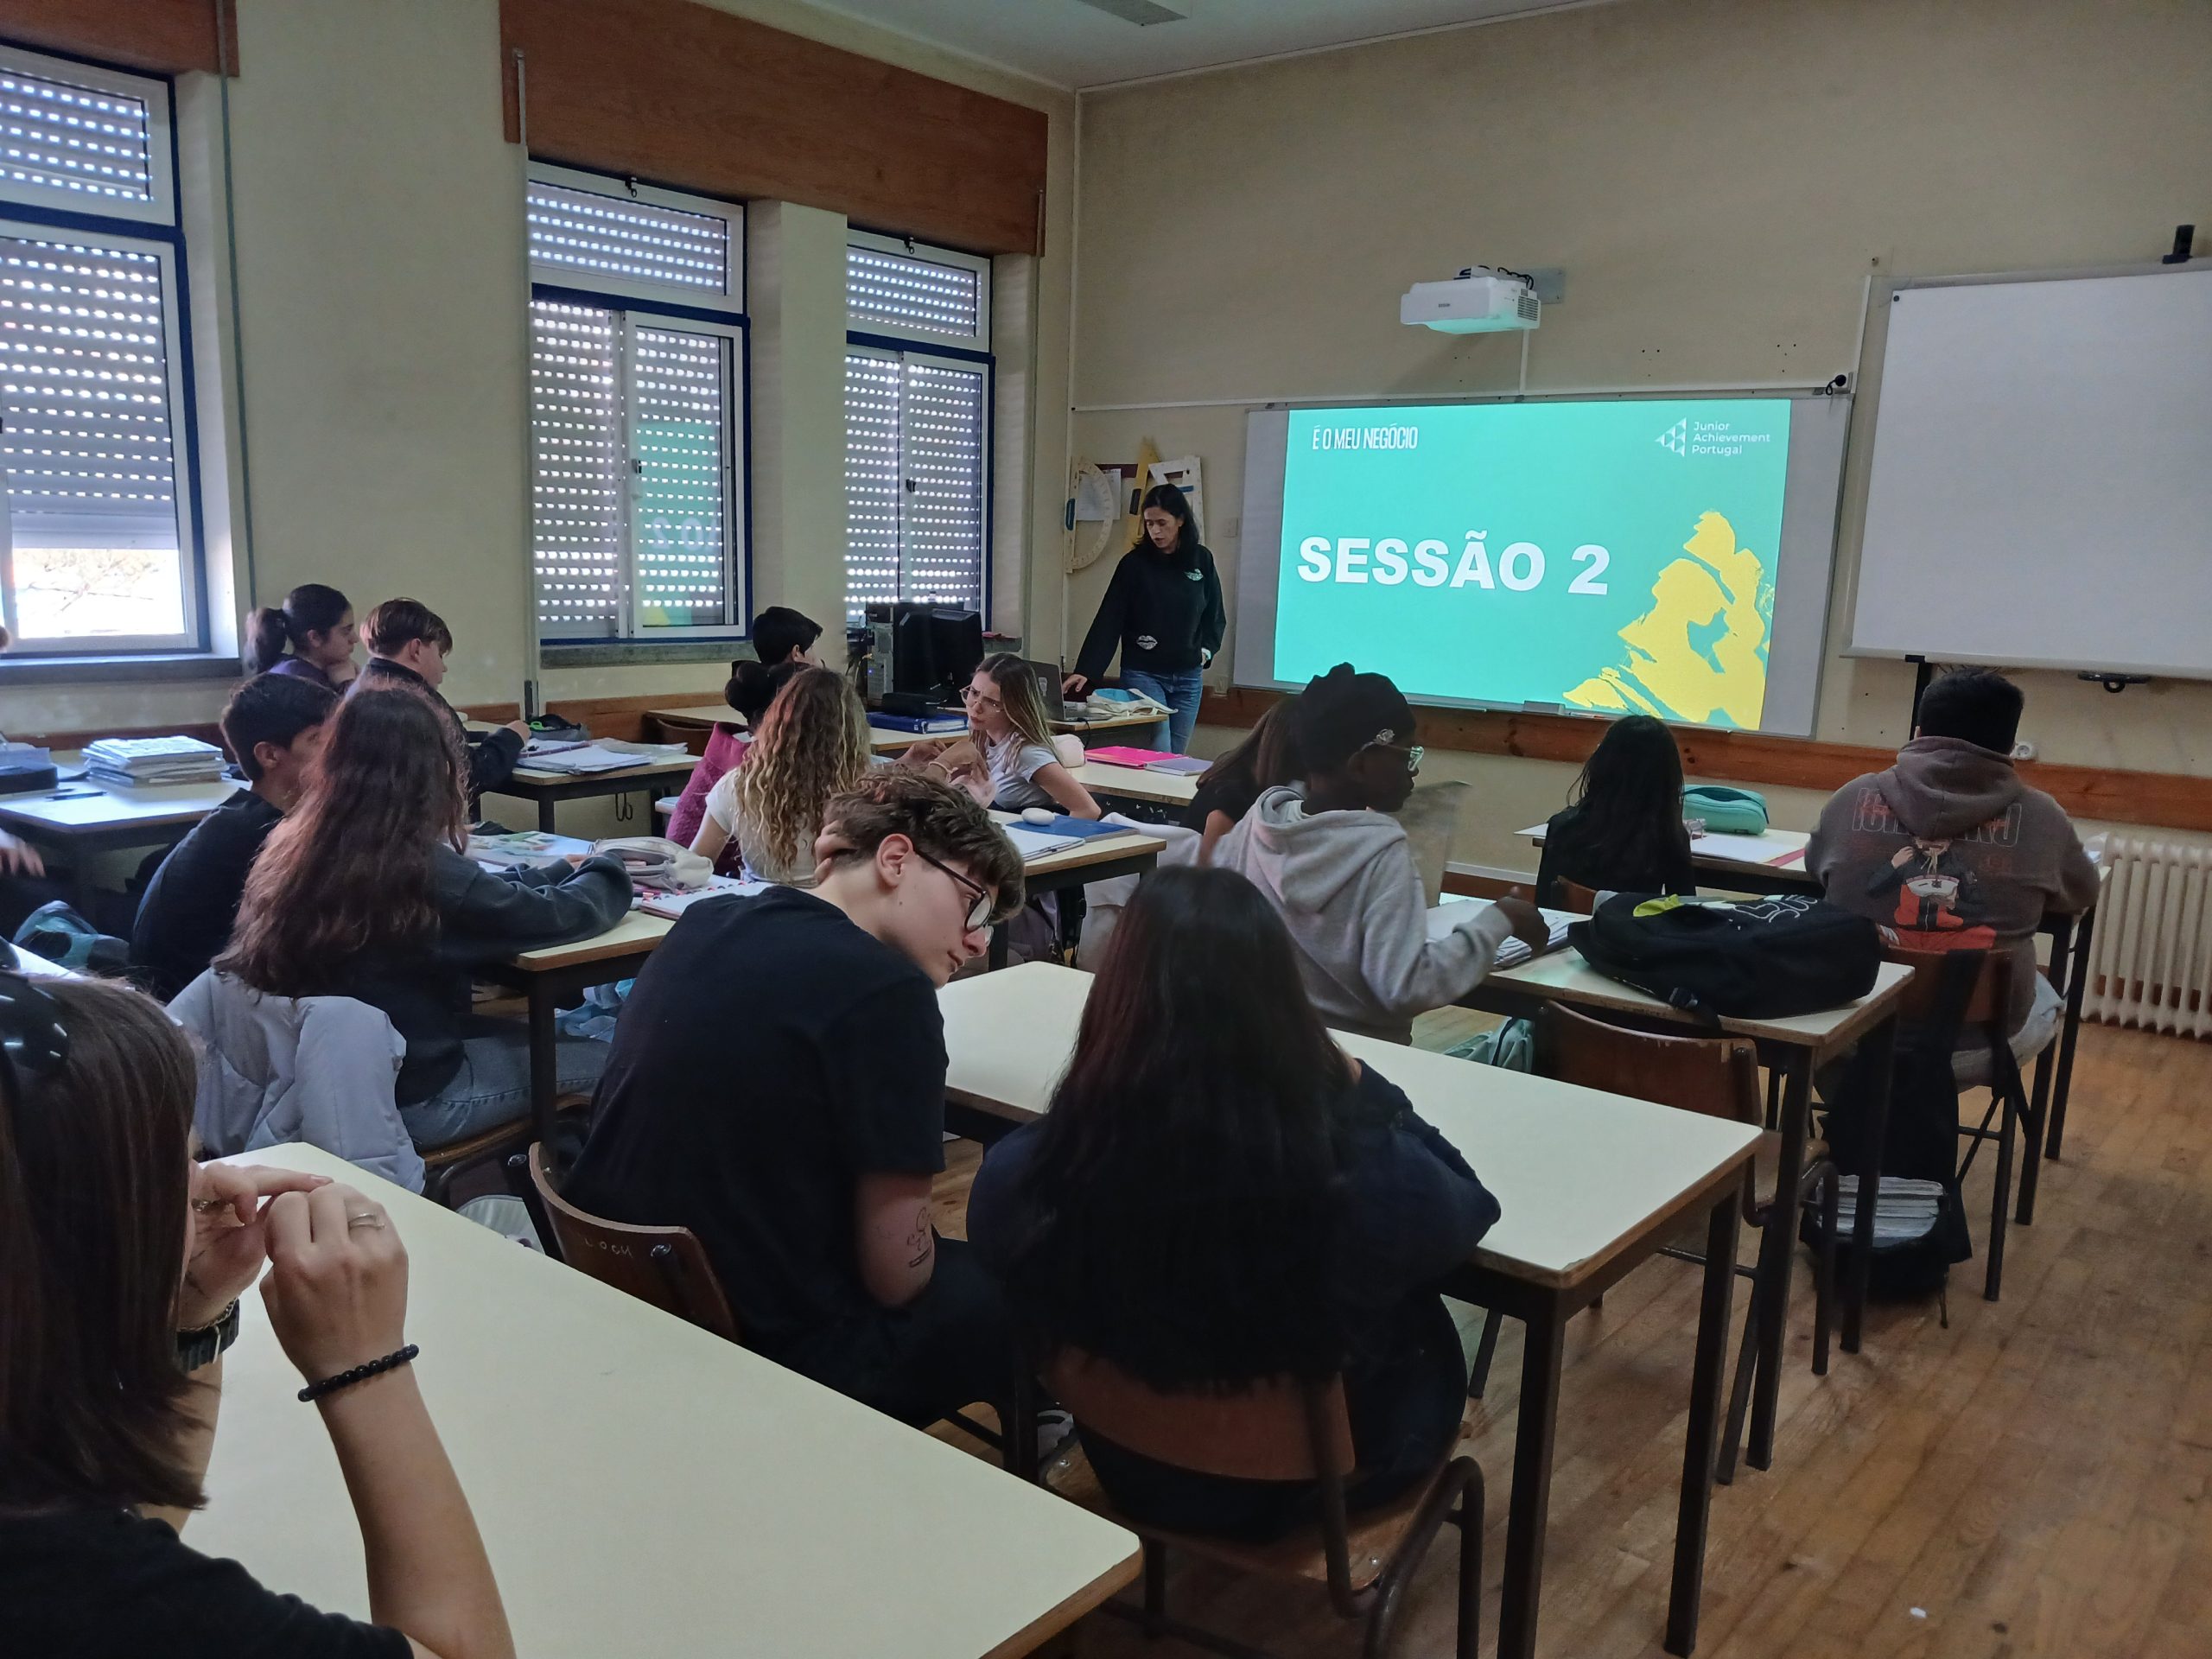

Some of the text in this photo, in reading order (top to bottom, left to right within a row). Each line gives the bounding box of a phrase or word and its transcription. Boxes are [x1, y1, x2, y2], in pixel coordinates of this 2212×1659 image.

[1694, 421, 1730, 431] Junior
[1313, 423, 1419, 449] É O MEU NEGÓCIO
[1693, 433, 1770, 442] Achievement
[1692, 445, 1743, 456] Portugal
[1297, 530, 1611, 595] SESSÃO 2
